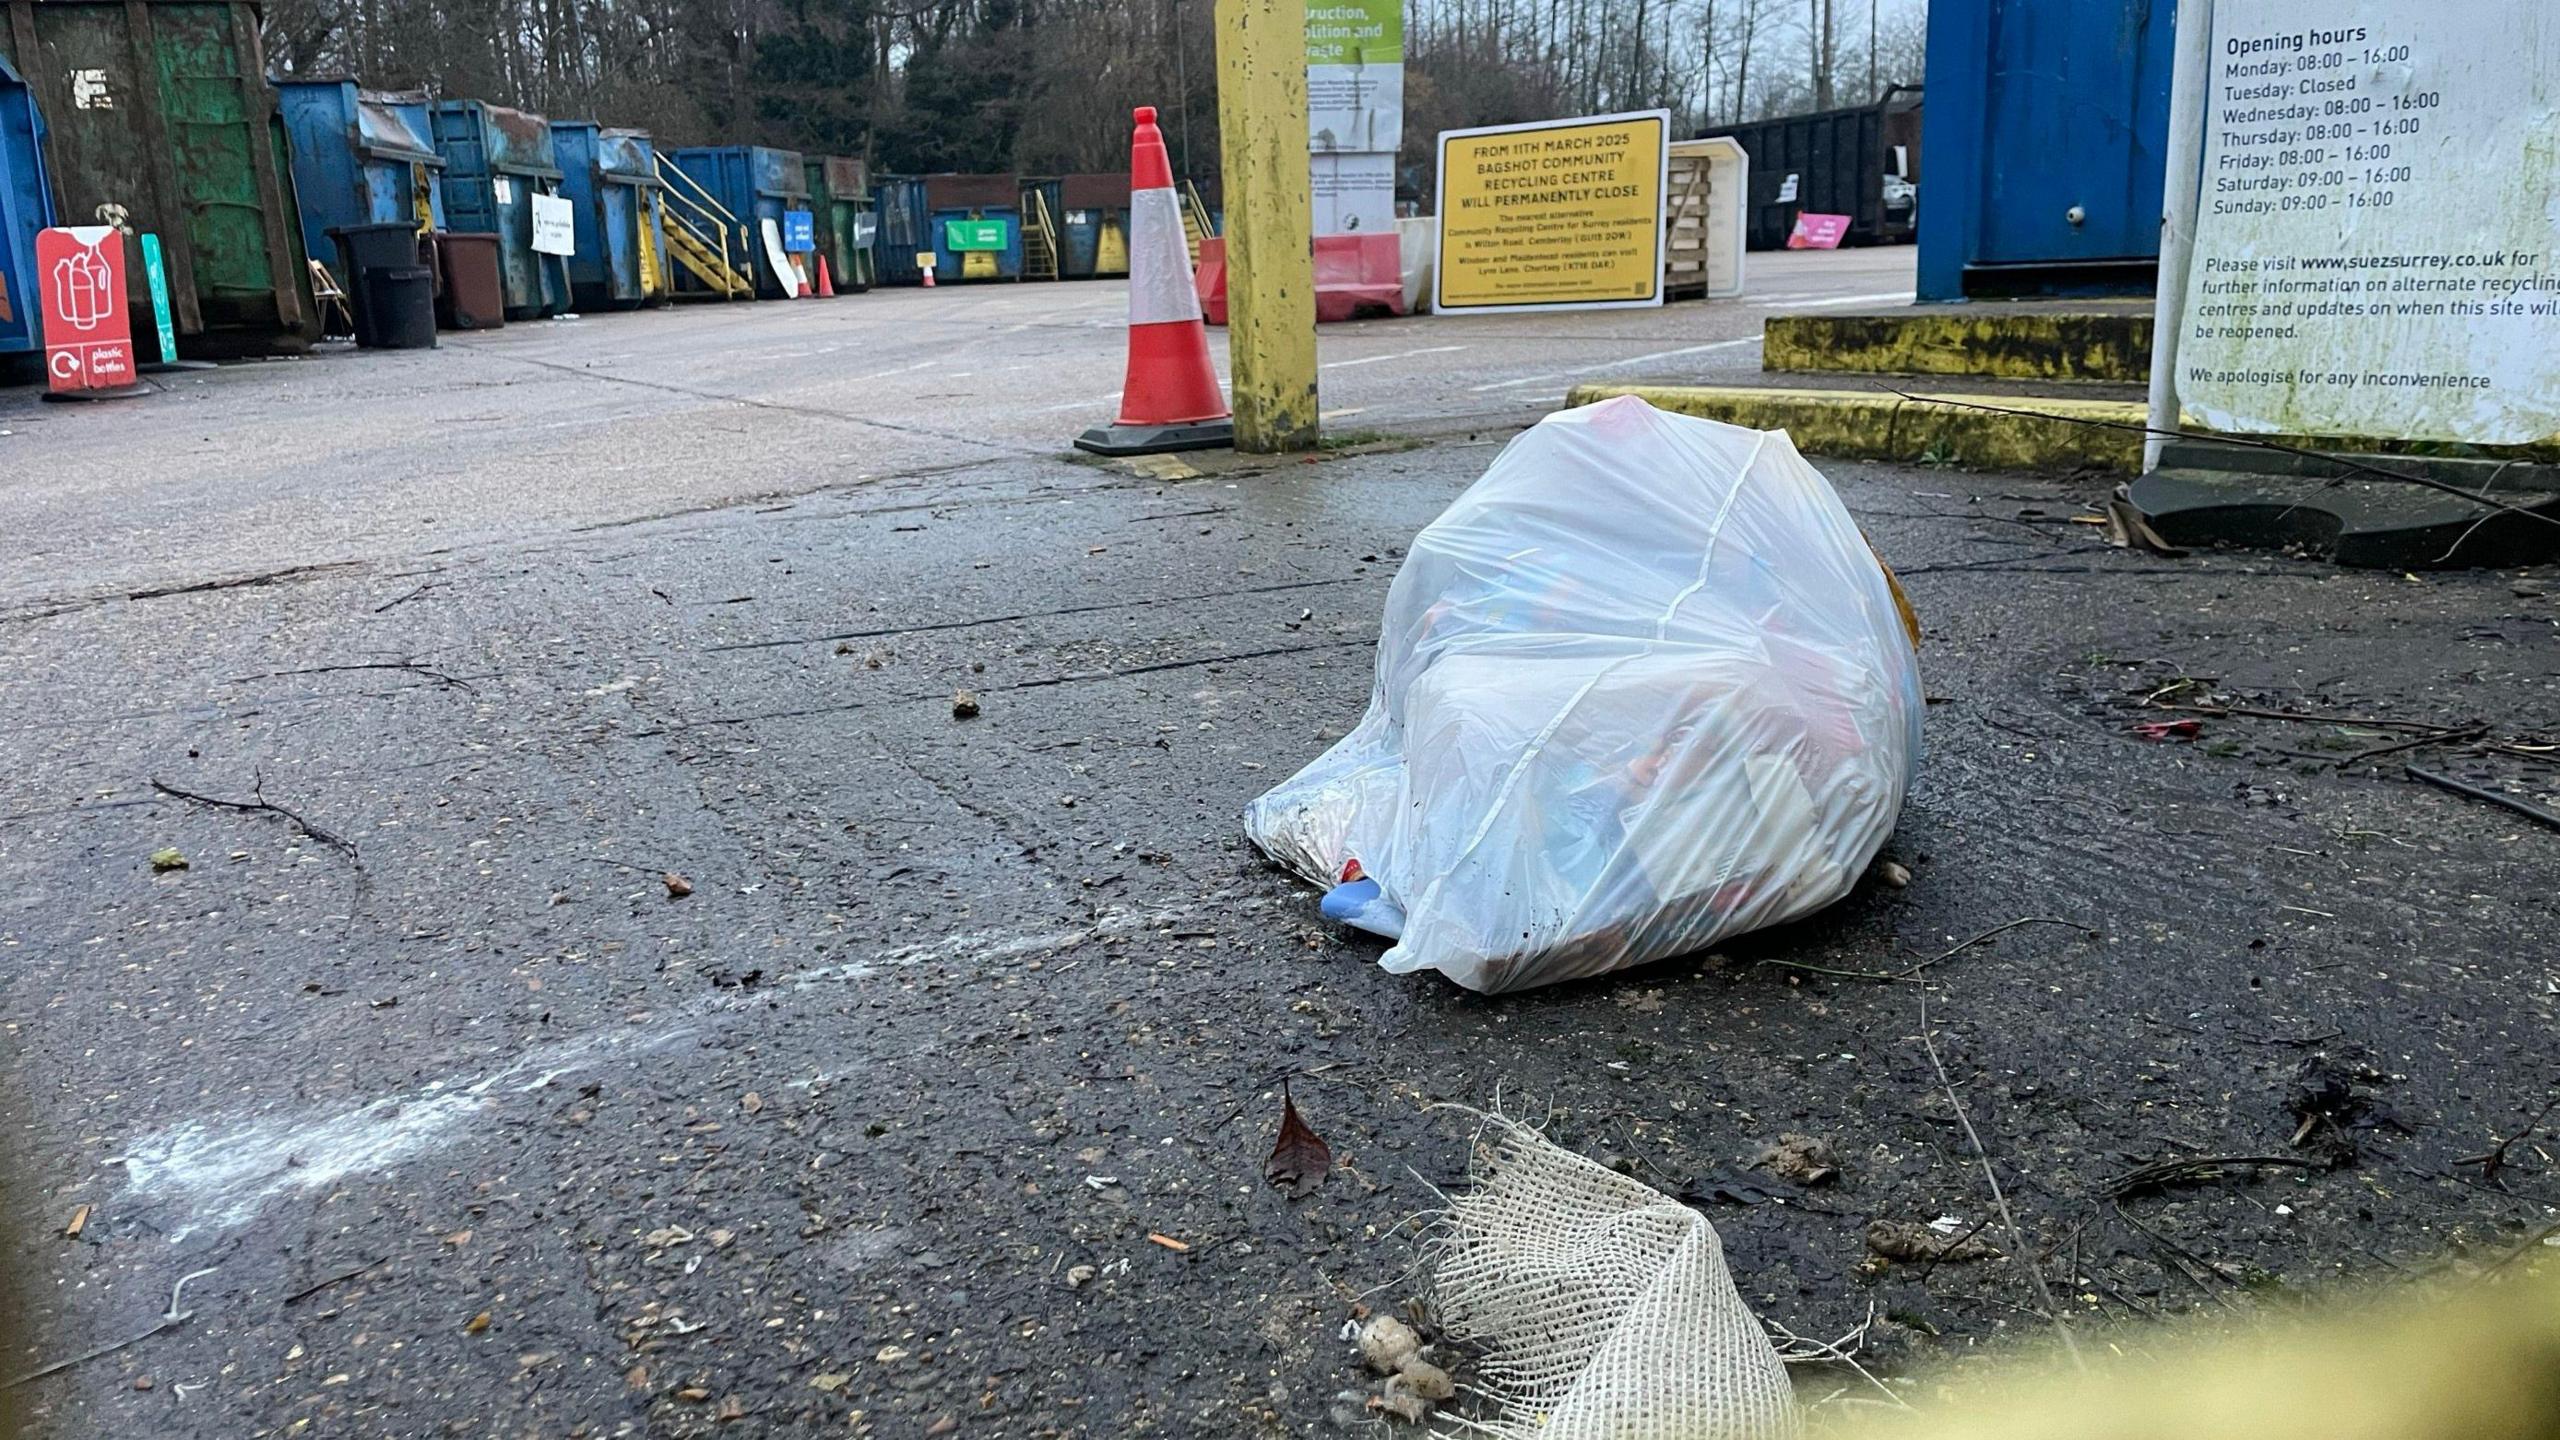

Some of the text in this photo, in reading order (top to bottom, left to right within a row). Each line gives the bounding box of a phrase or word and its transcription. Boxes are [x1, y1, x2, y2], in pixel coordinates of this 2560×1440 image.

[1354, 22, 1383, 38] and
[2227, 27, 2367, 57] Opening hours
[2226, 61, 2292, 79] Monday:
[2297, 52, 2343, 71] 08:00
[2363, 45, 2409, 65] 16:00
[2225, 75, 2356, 101] Tuesday: Closed
[2223, 104, 2320, 124] Wednesday:
[2324, 97, 2371, 116] 08:00
[2392, 92, 2440, 110] 16:00
[2222, 128, 2301, 147] Thursday:
[2306, 123, 2352, 141] 08:00
[2373, 117, 2420, 136] 16:00
[1474, 133, 1630, 158] FROM 11TH MARCH 2025
[2220, 154, 2274, 170] Friday:
[2279, 148, 2325, 166] 08:00
[2345, 144, 2391, 162] 16:00
[1477, 152, 1625, 174] BAGSHOT COMMUNITY
[1485, 170, 1615, 191] RECYCLING CENTRE
[2216, 175, 2293, 192] Saturday:
[2298, 170, 2344, 188] 09:00
[2365, 166, 2411, 184] 16:00
[1462, 185, 1638, 209] WILL PERMANENTLY CLOSE
[2213, 199, 2277, 215] Sunday:
[2281, 194, 2327, 211] 09:00
[2348, 191, 2394, 208] 16:00
[2205, 250, 2539, 272] Please visit www.suezsurrey.co.uk for
[2202, 278, 2258, 294] further
[2263, 278, 2360, 293] information
[2365, 280, 2388, 292] on
[2392, 277, 2476, 292] alternate
[2199, 299, 2560, 319] centres and updates on when this site wil
[2196, 323, 2299, 341] be reopened.
[92, 347, 123, 360] plastic
[93, 361, 126, 374] bottles
[2189, 368, 2491, 389] We apologise for any inconvenience
